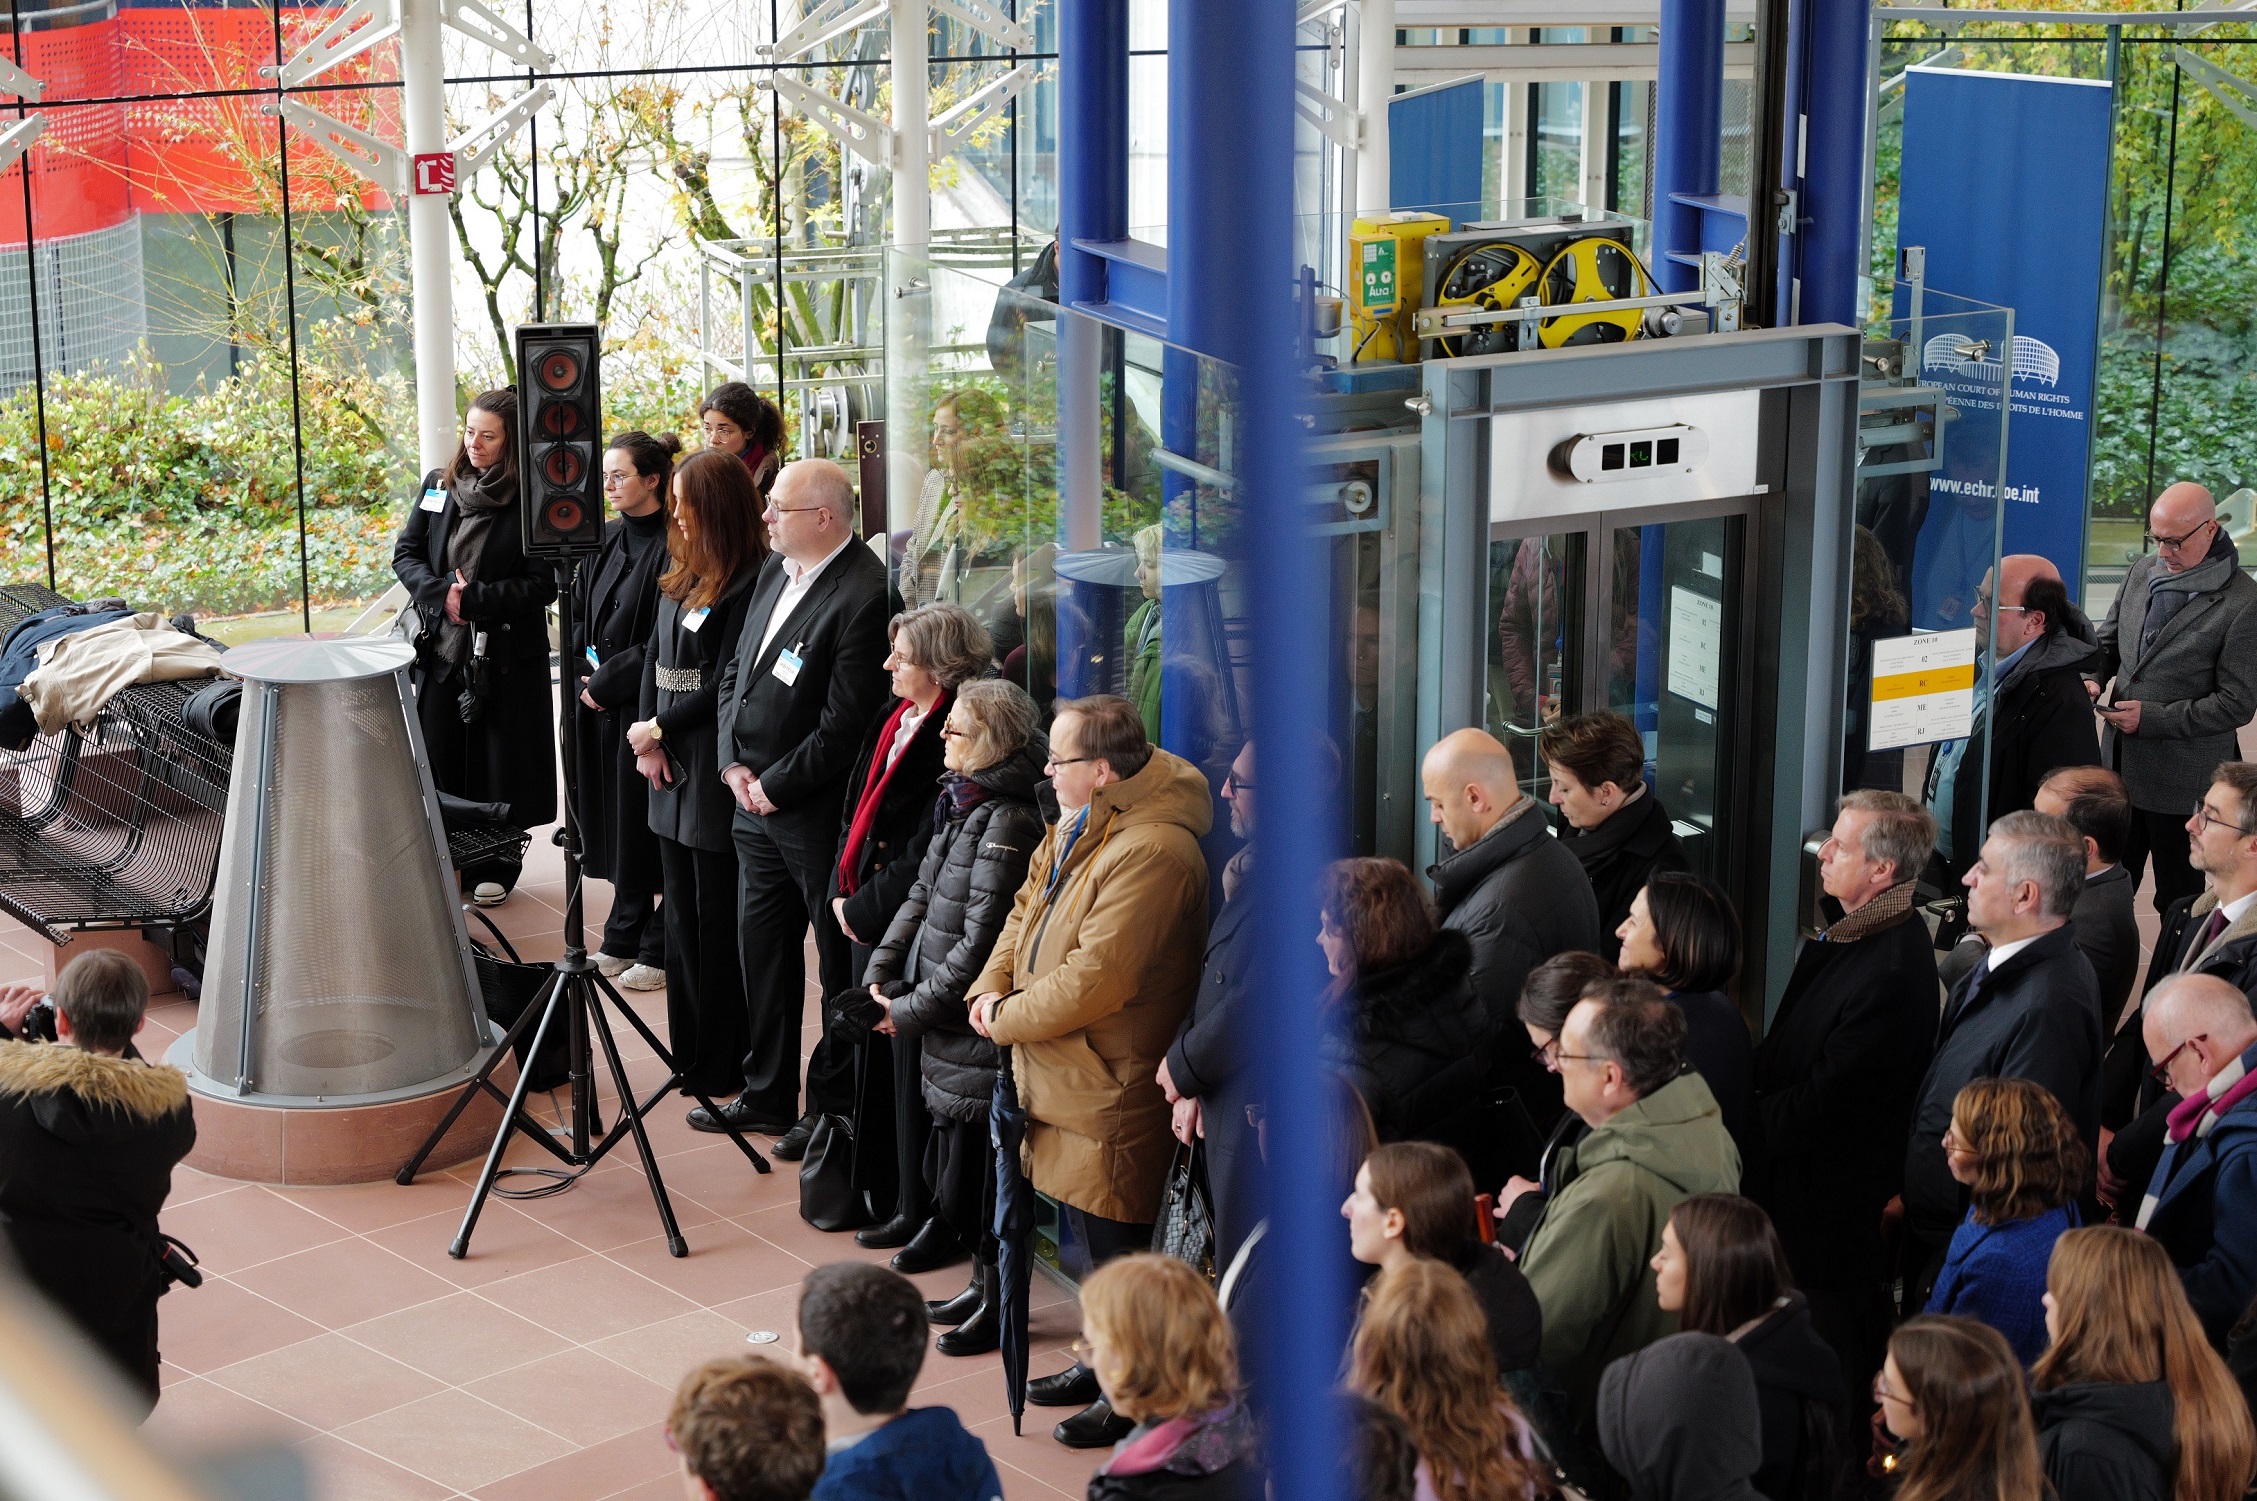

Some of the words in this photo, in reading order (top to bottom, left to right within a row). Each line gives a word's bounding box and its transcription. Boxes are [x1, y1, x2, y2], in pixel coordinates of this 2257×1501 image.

[1917, 379, 1956, 392] UROPEAN
[1957, 383, 1987, 396] COURT
[1987, 387, 2001, 396] OF
[2001, 388, 2036, 402] UMAN
[2038, 392, 2070, 404] RIGHTS
[1978, 401, 1995, 410] DES
[1997, 402, 2028, 413] DOITS
[2029, 406, 2040, 415] DE
[2042, 407, 2084, 420] L'HOMME
[1929, 476, 2040, 504] www.echr.oe.int
[1913, 637, 1931, 646] ZONE
[1921, 655, 1928, 663] 02
[1919, 679, 1928, 688] RC
[1917, 703, 1927, 712] ME
[1917, 727, 1925, 736] RJ
